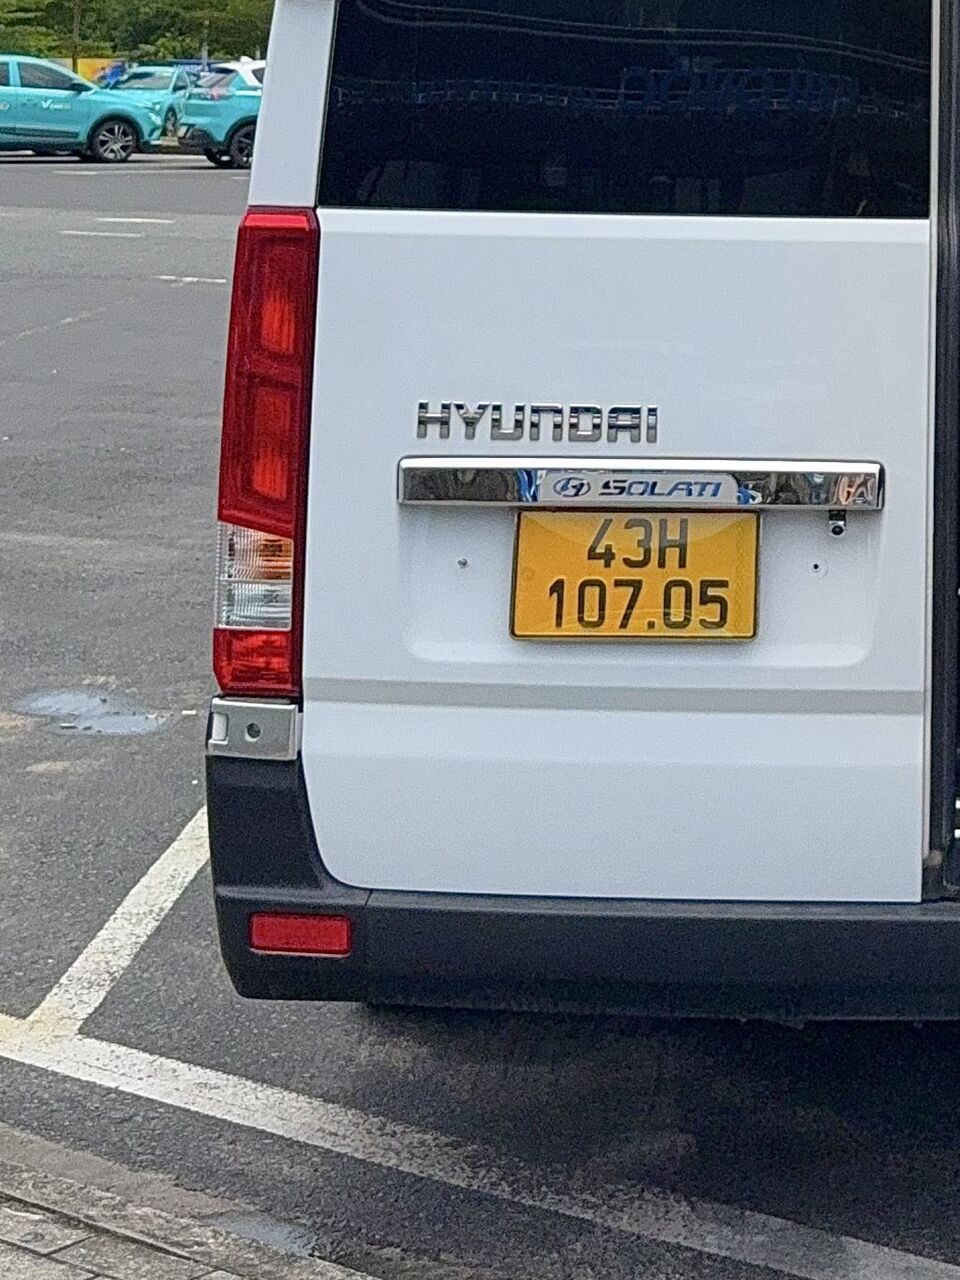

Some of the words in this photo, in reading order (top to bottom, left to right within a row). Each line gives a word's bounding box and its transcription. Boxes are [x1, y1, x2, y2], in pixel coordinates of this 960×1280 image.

[416, 399, 659, 444] HYUNDAI
[597, 479, 722, 498] SOLATI
[586, 517, 688, 569] 43H
[548, 577, 730, 630] 107.05
